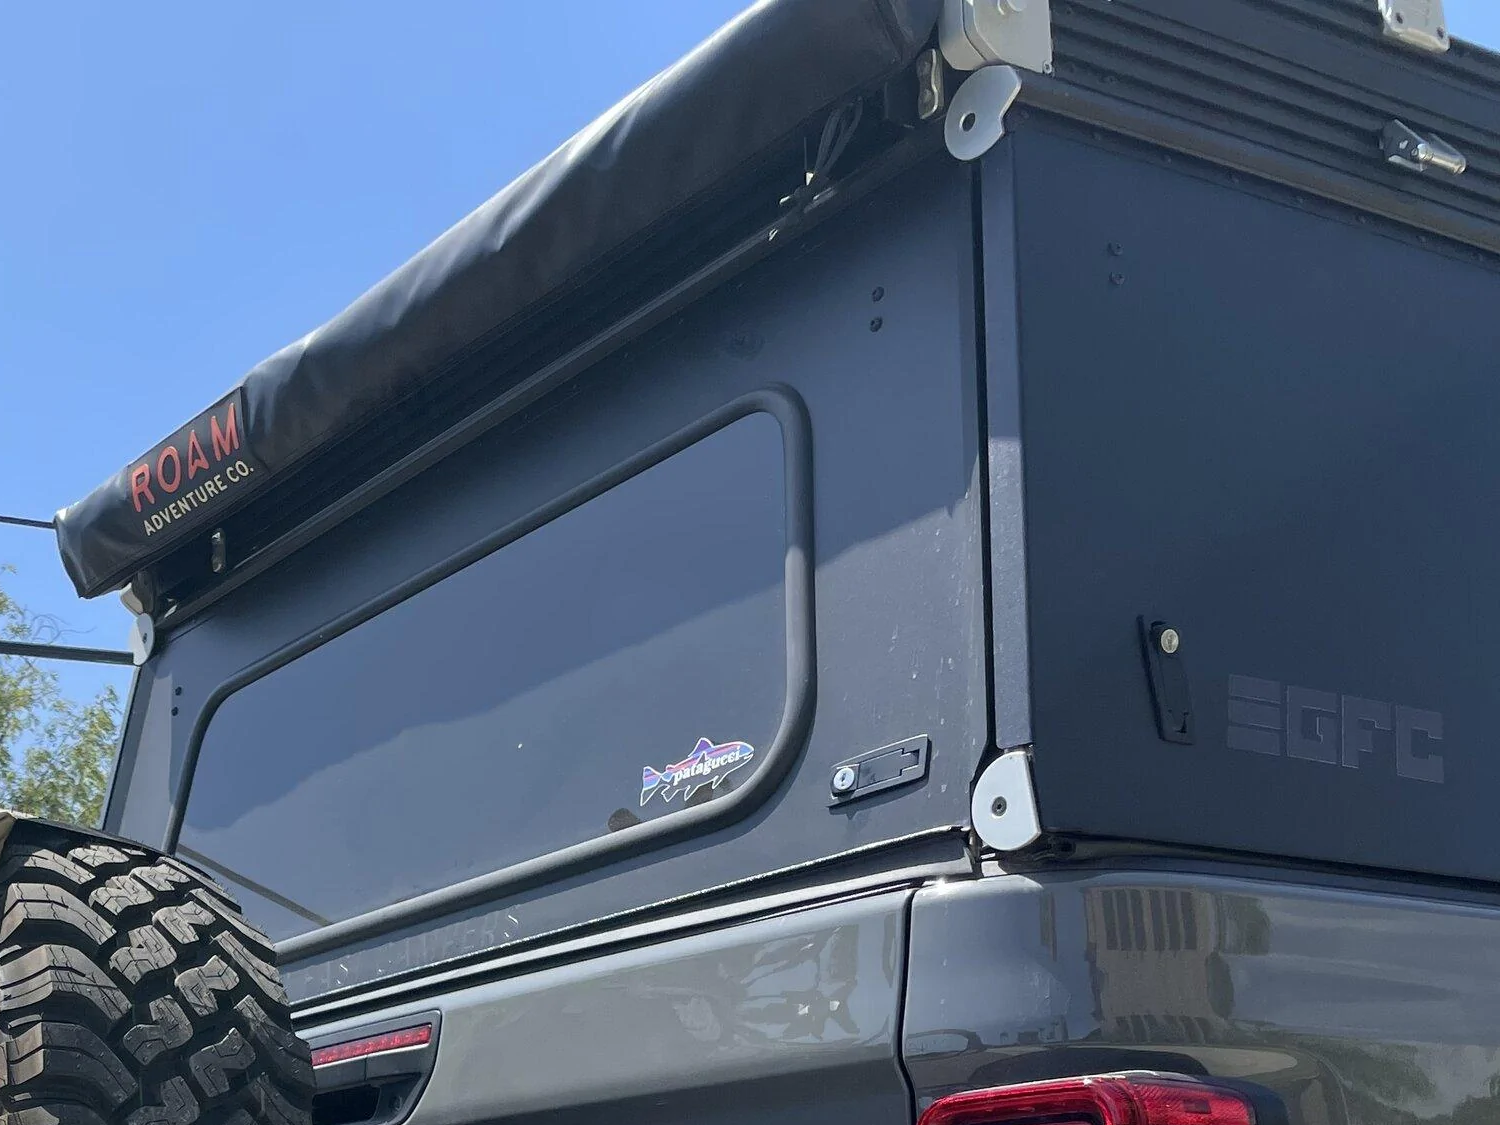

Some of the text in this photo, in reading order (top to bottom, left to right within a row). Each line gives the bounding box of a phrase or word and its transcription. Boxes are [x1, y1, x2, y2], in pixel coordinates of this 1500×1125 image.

[131, 402, 240, 513] ROAM
[143, 460, 254, 536] ADVENTURE CO.
